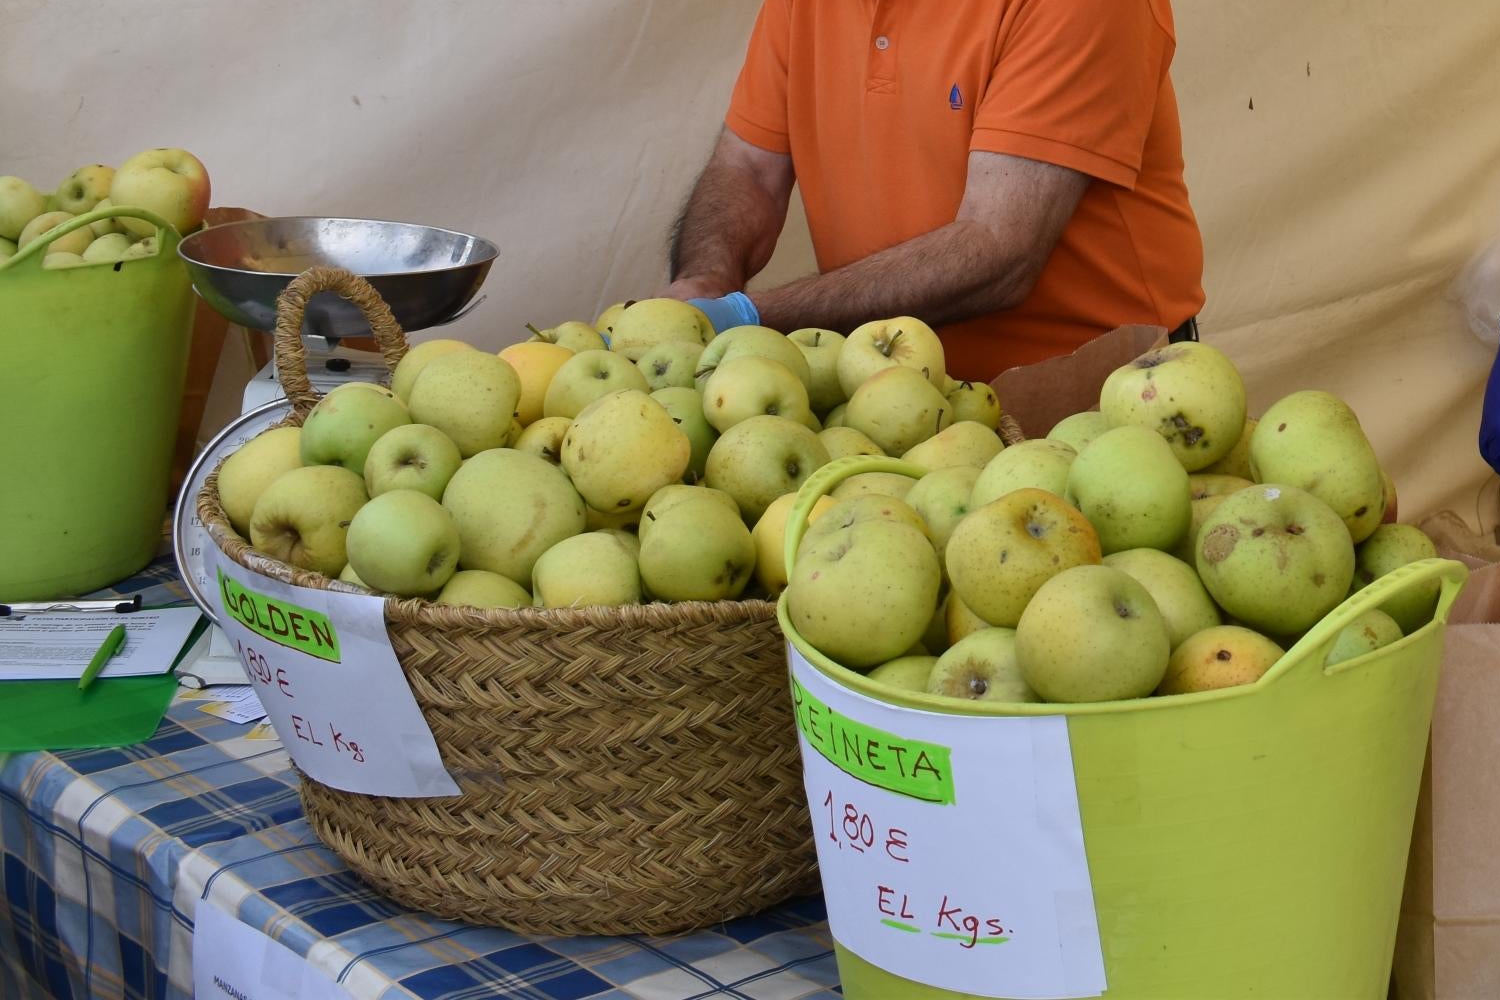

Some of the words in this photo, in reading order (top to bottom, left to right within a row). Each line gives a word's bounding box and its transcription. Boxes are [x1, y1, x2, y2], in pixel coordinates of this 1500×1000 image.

[223, 576, 334, 650] GOLDEN
[292, 715, 323, 746] EL
[878, 886, 914, 919] EL
[937, 895, 1013, 949] Kgs.
